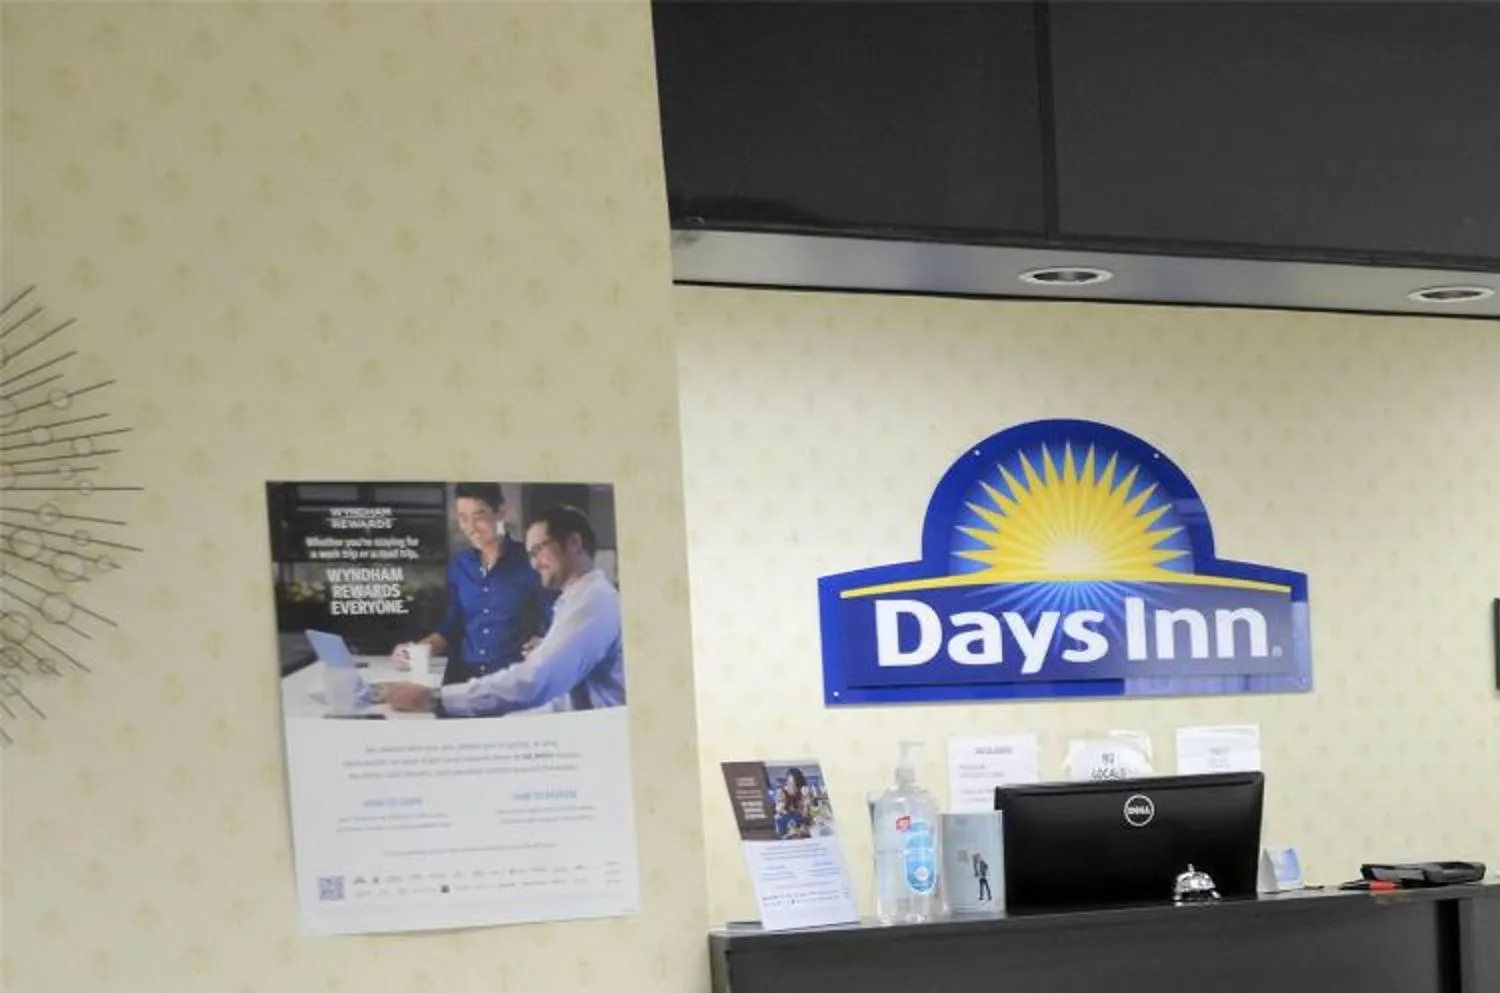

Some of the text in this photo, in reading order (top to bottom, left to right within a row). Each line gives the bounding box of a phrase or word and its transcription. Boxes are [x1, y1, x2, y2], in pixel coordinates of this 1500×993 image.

[330, 518, 394, 530] REWARDS
[326, 567, 404, 582] WYNDHAM
[331, 583, 401, 600] REWARDS
[874, 596, 1270, 675] Days Inn
[1126, 805, 1152, 816] DELL
